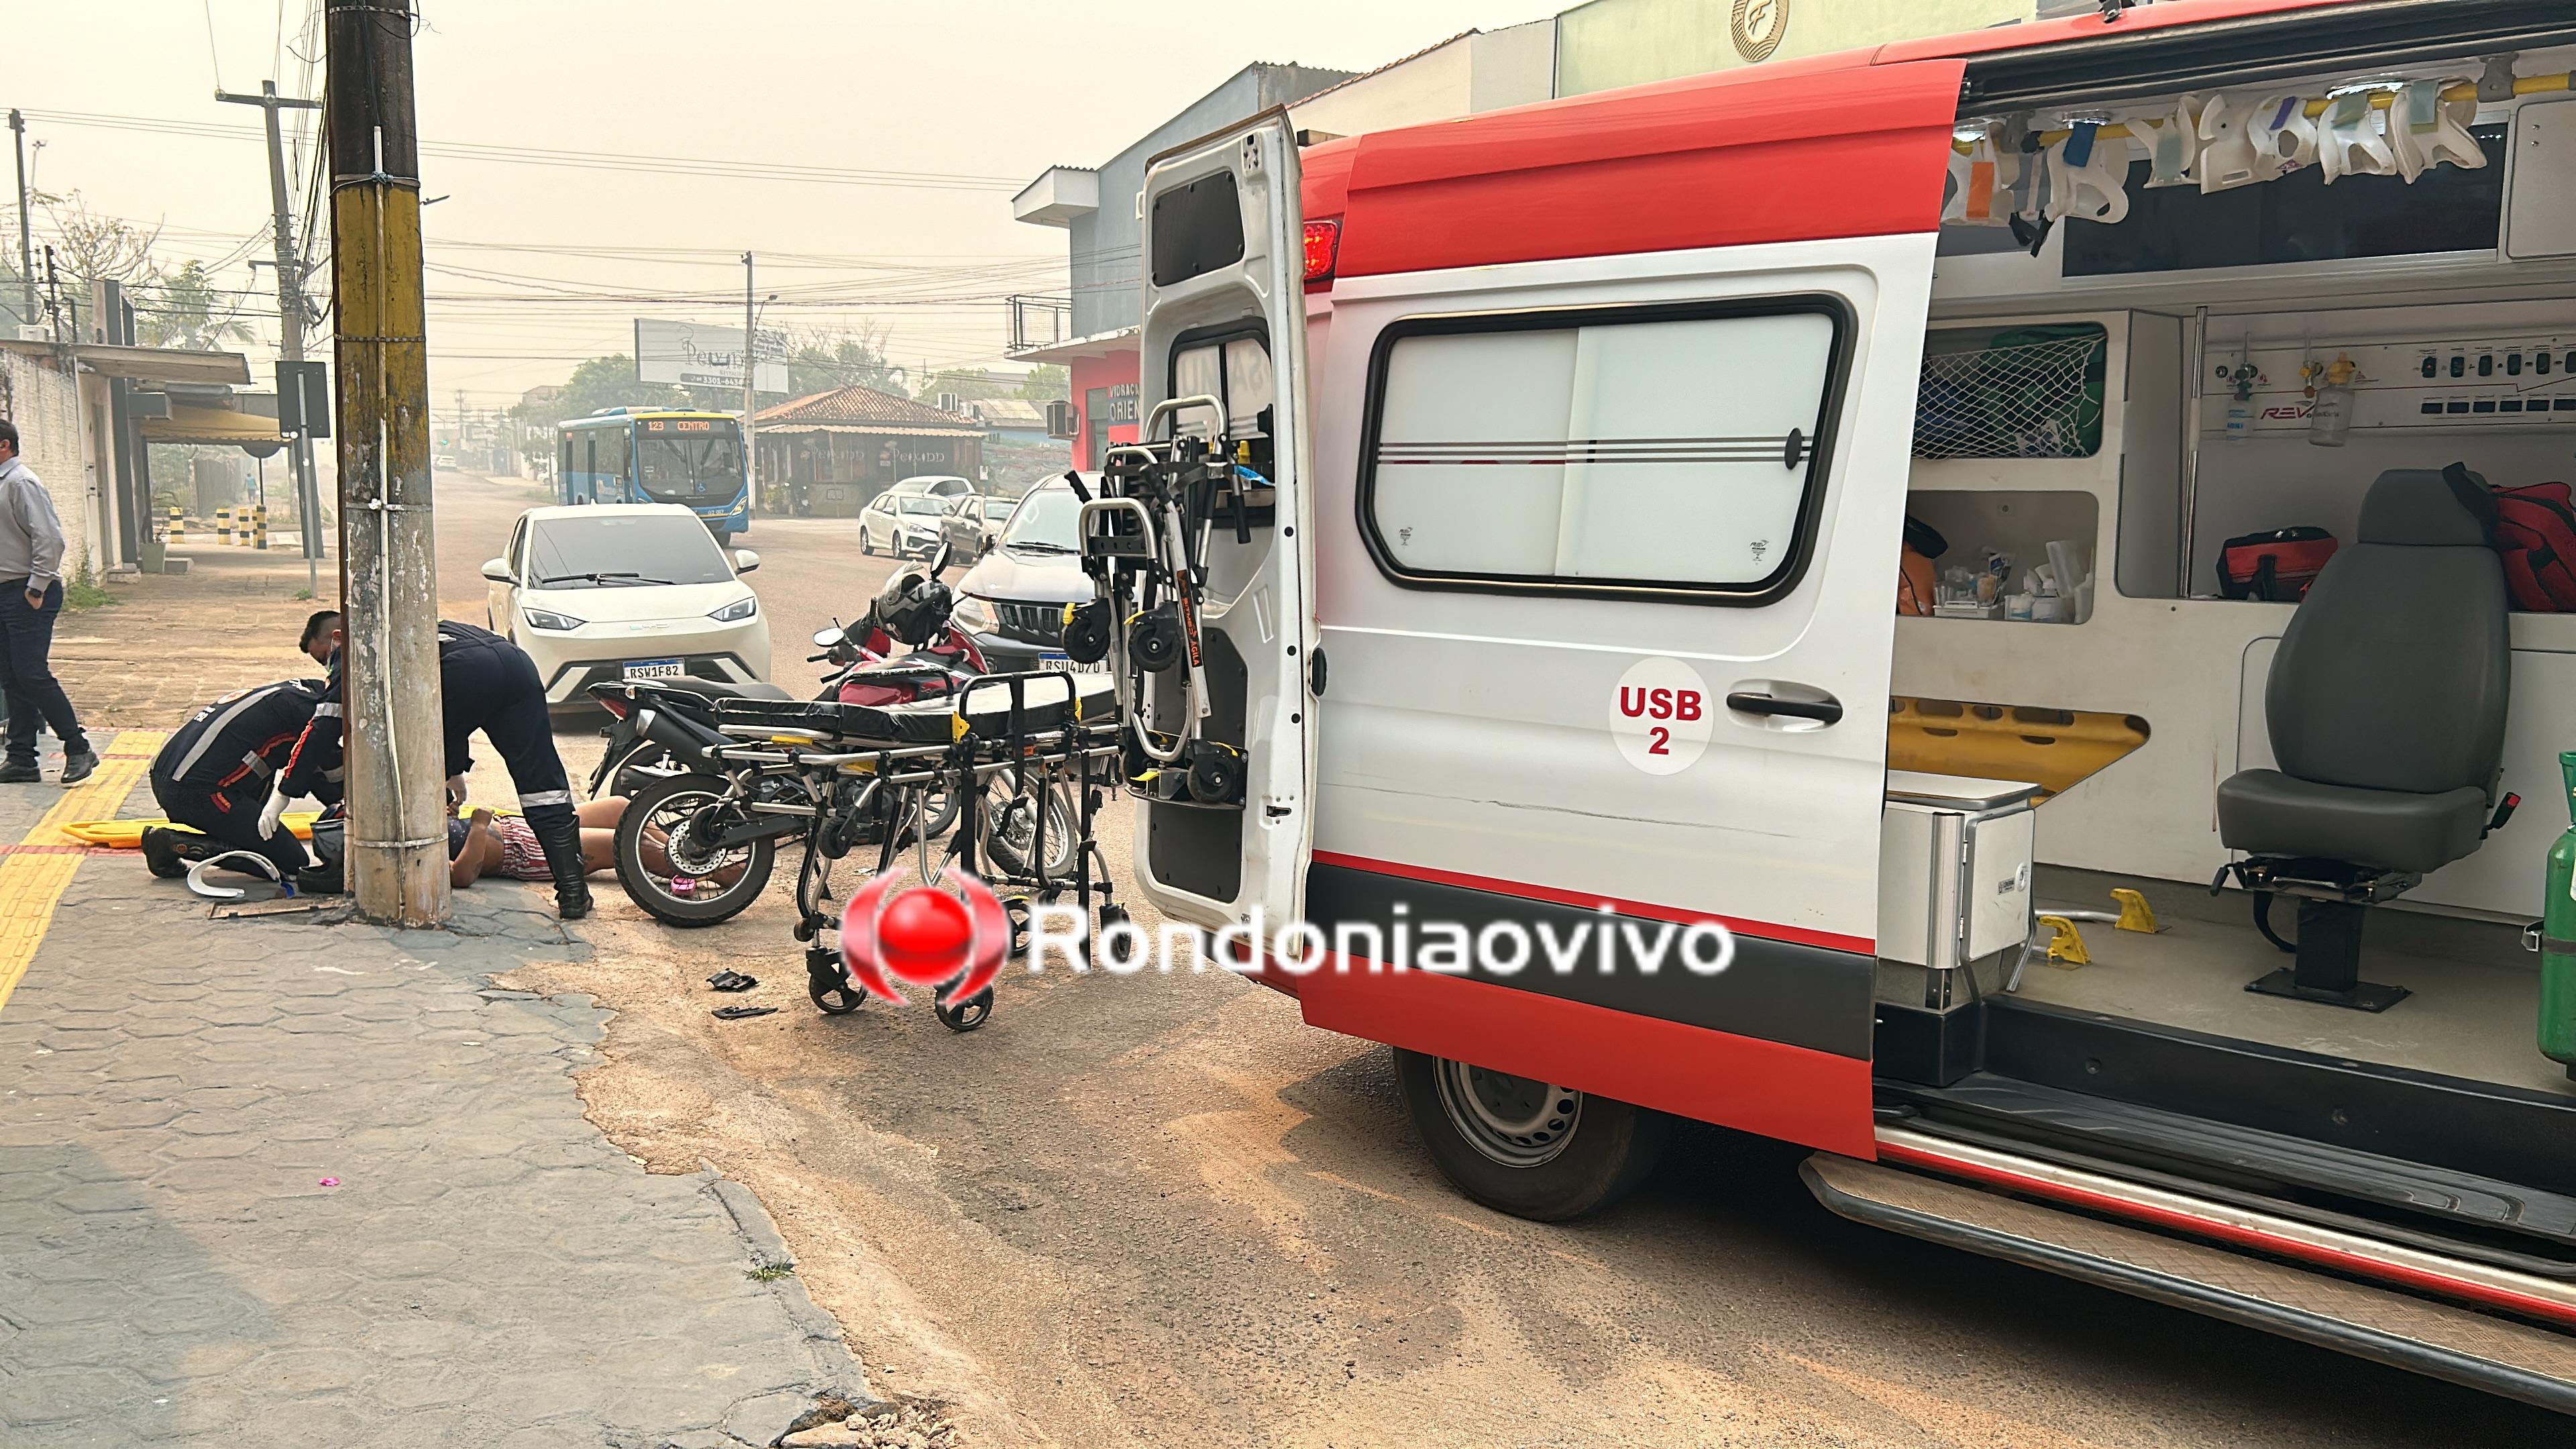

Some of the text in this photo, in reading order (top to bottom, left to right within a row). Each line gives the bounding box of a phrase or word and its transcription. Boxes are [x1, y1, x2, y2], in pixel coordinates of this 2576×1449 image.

[648, 421, 710, 431] 123 CENTRO
[631, 665, 679, 679] RSW1F82
[1621, 687, 1702, 721] USB
[1648, 727, 1669, 755] 2
